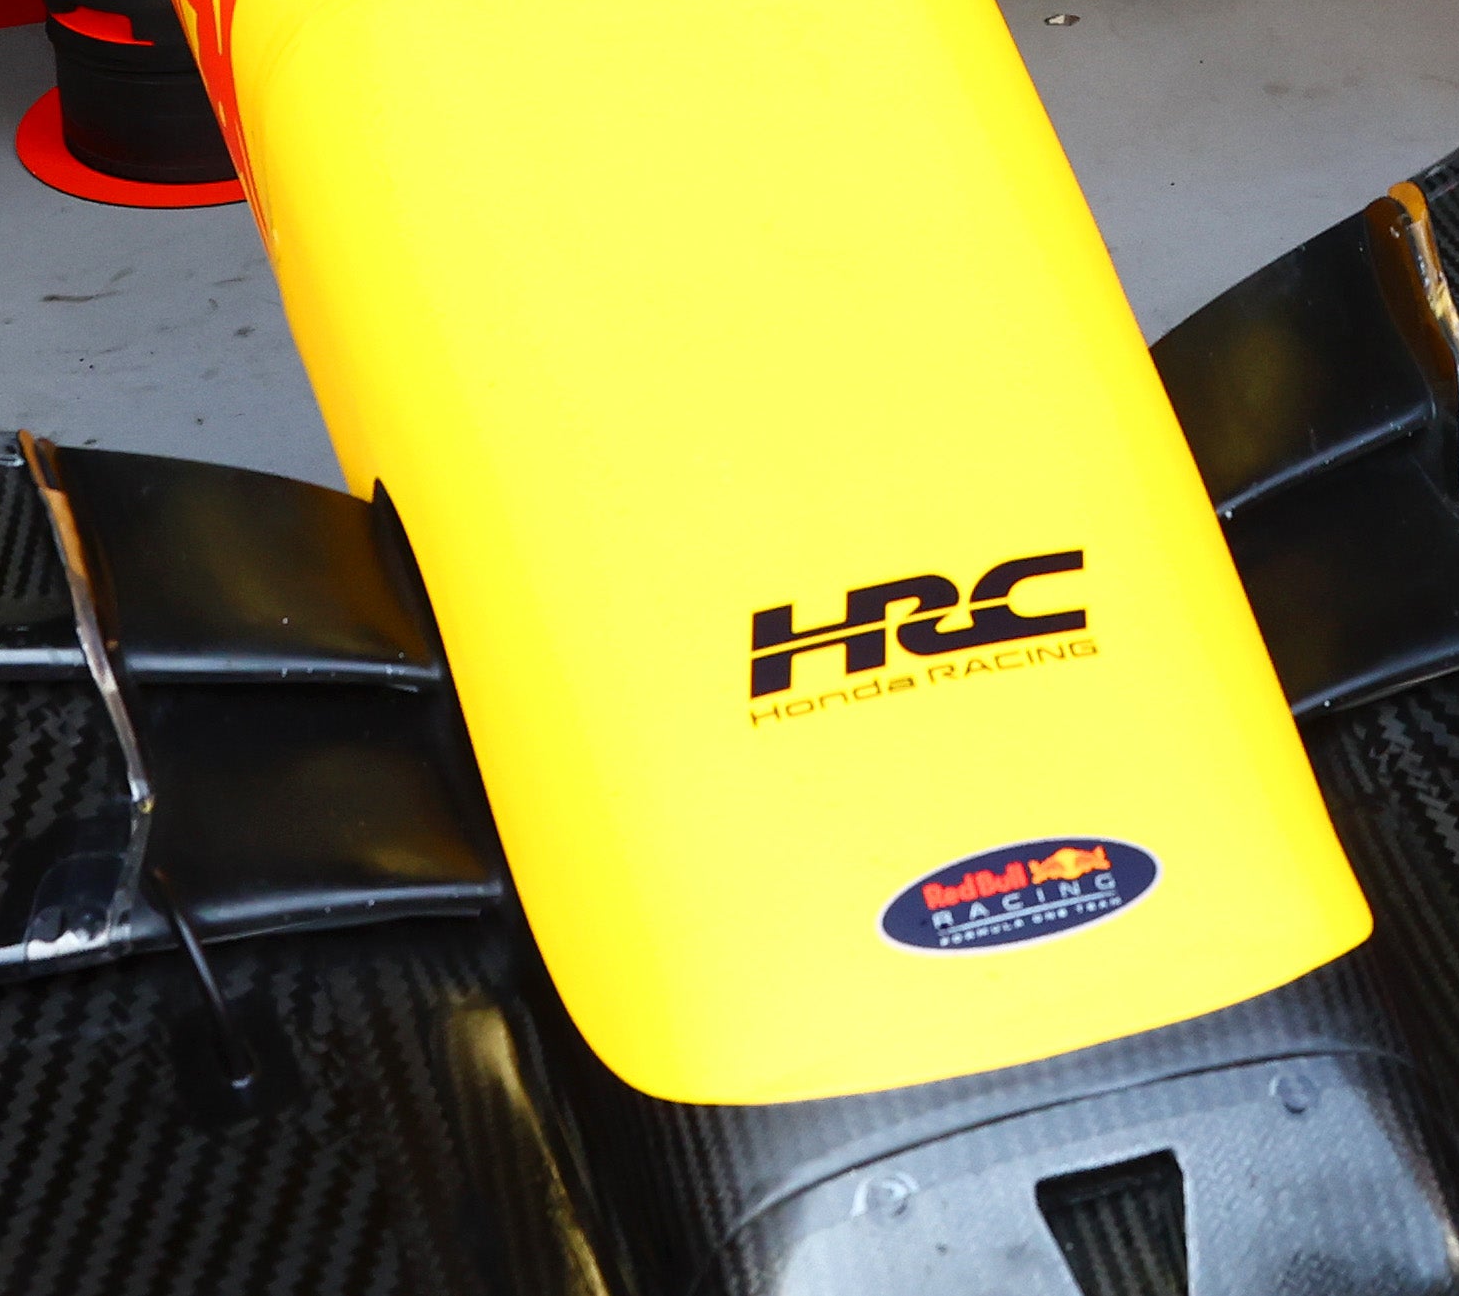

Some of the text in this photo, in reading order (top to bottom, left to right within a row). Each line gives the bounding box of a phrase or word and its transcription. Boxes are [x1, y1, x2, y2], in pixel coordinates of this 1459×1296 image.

[749, 549, 1087, 699] HRC
[749, 638, 1099, 727] Honda RACING
[931, 870, 1117, 931] RACING
